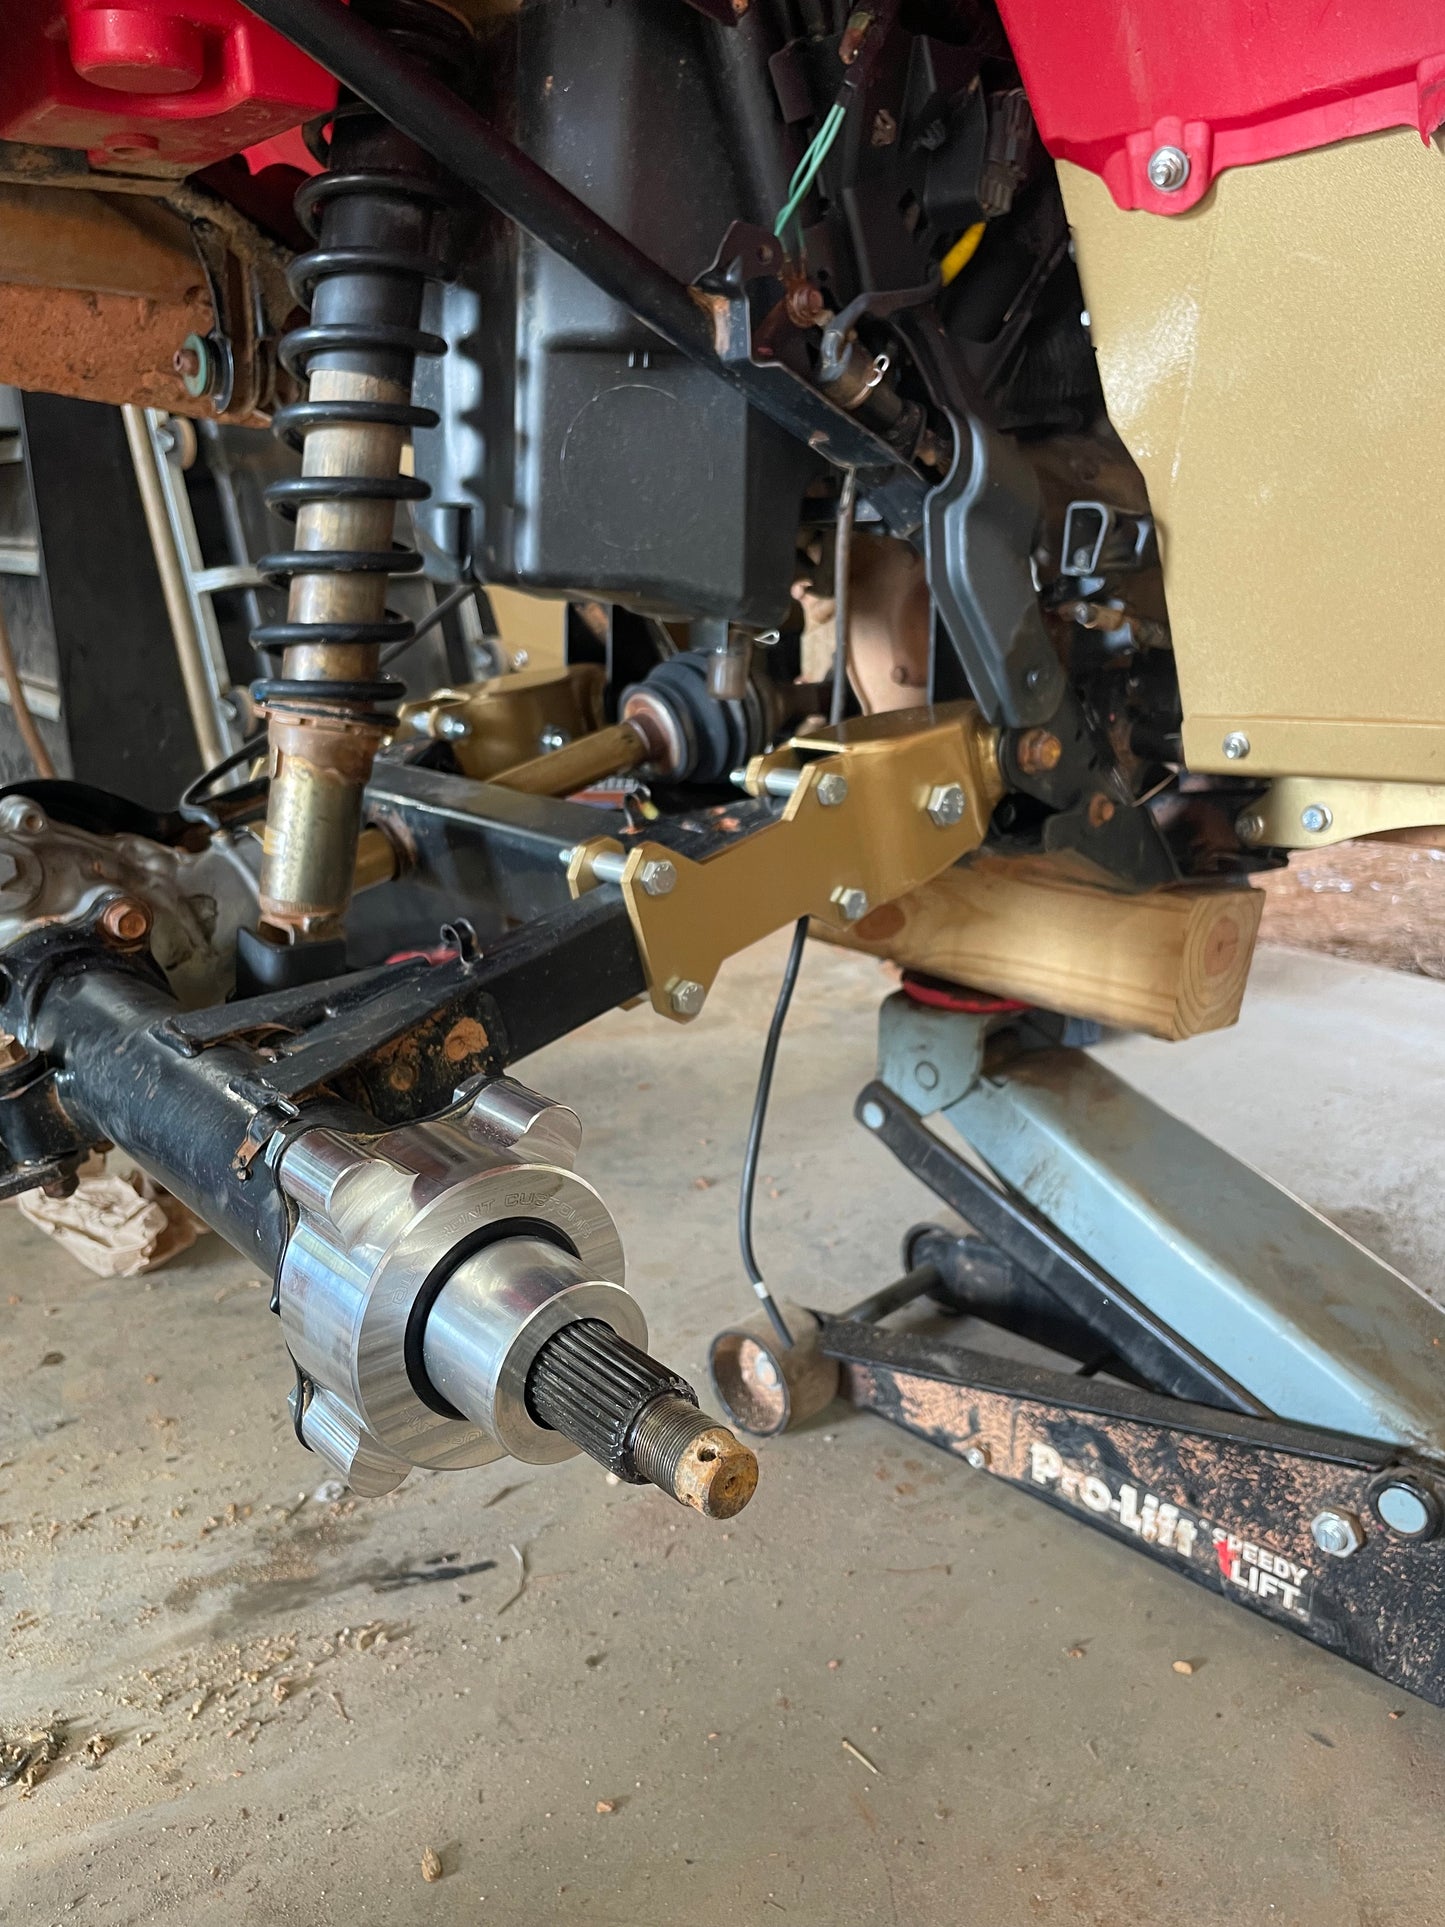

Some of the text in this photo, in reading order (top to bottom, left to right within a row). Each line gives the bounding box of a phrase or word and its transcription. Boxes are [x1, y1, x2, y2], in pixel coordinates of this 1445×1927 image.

[504, 1192, 593, 1239] CUSTOMS
[1030, 1441, 1198, 1558] Pro-Lift
[1211, 1527, 1309, 1587] SPEEDY
[1229, 1559, 1302, 1610] LIFT
